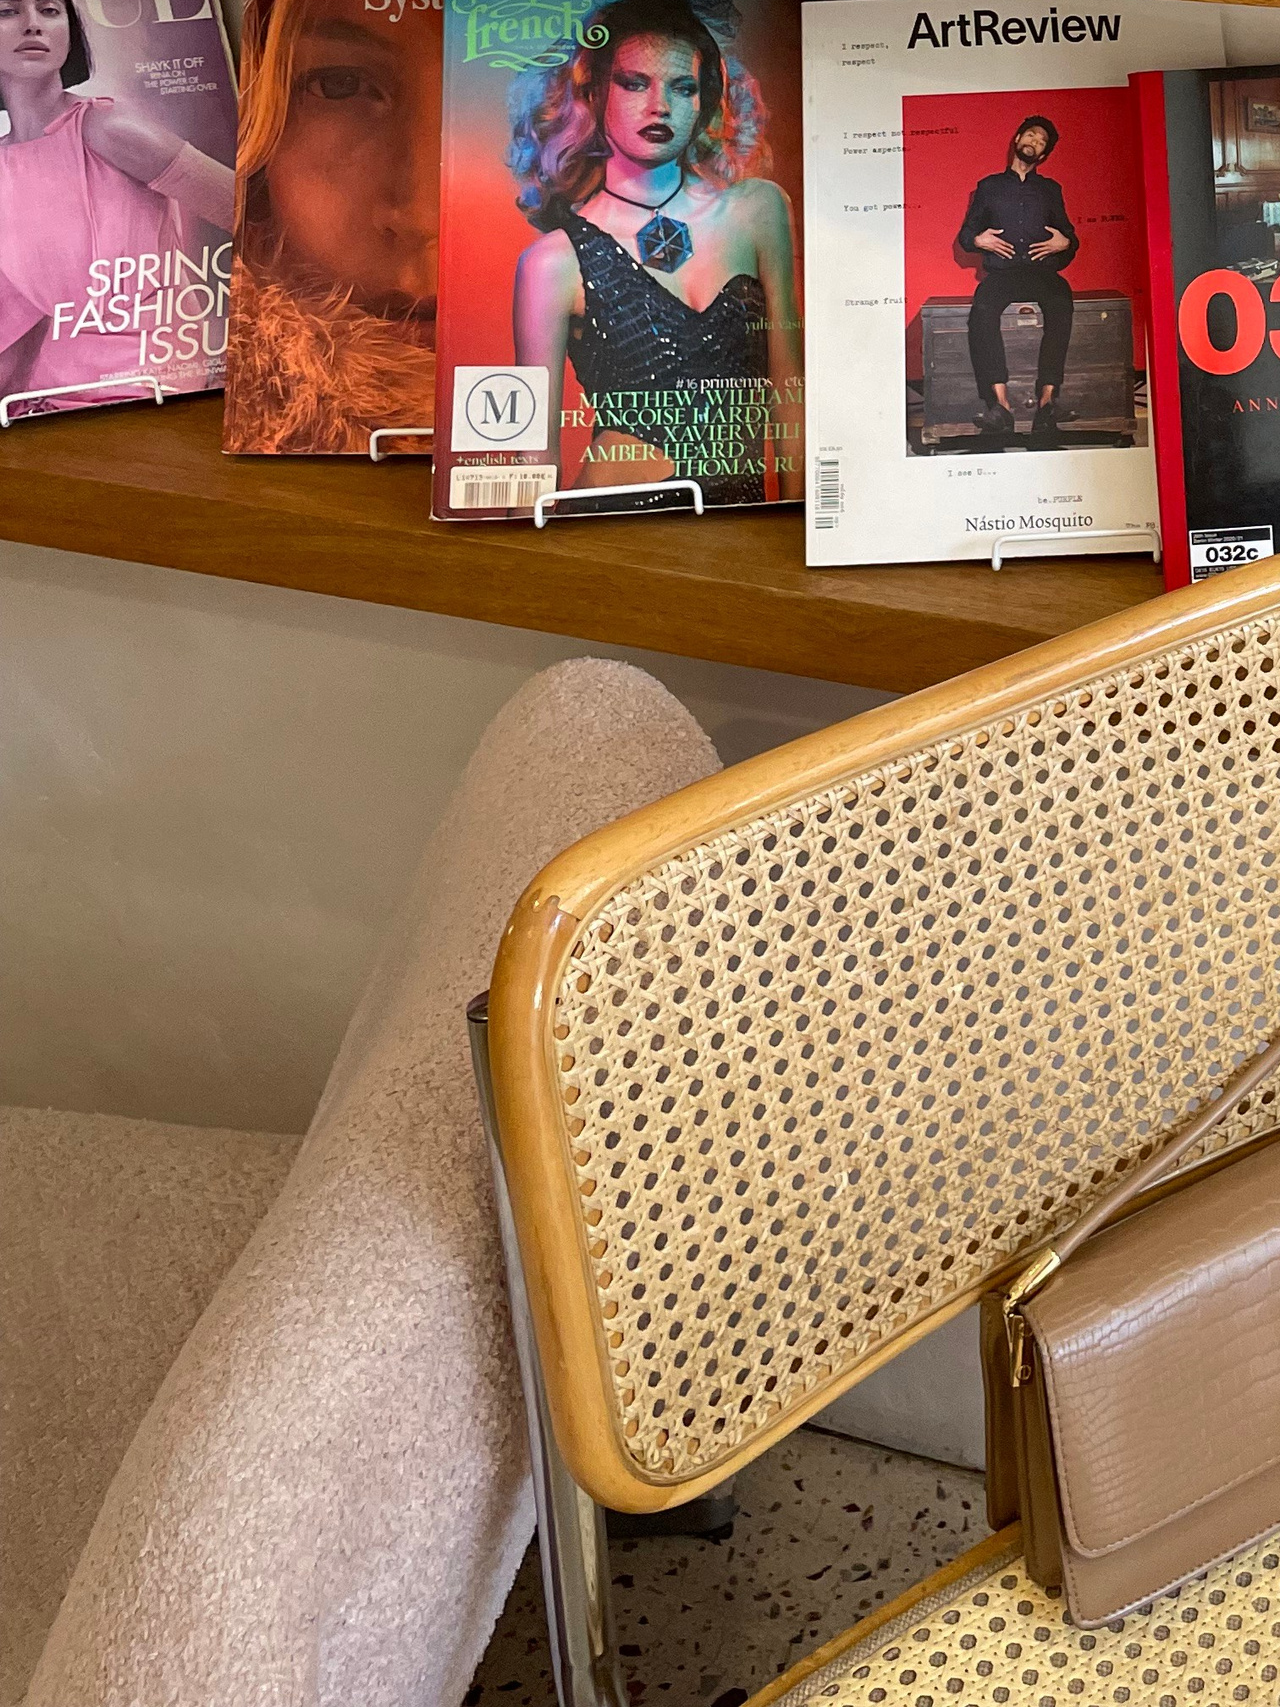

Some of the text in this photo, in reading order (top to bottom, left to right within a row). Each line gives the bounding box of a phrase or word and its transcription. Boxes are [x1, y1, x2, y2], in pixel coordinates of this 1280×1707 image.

[907, 7, 1121, 50] ArtReview
[135, 57, 205, 73] SHAYK IT OFF
[841, 57, 876, 67] respect
[853, 129, 887, 140] respect
[844, 204, 878, 213] You got
[845, 296, 908, 307] Strange fruit
[700, 375, 774, 394] printemps
[480, 389, 521, 425] M
[579, 389, 697, 410] MATTHEW
[560, 404, 776, 433] FRANÇOISE HARDY
[664, 424, 743, 444] XAVIER
[510, 453, 539, 465] texts
[579, 441, 746, 463] AMBER HEARD
[670, 457, 767, 478] THOMAS
[965, 511, 1094, 533] Nástio Mosquito
[1205, 545, 1259, 563] 032c
